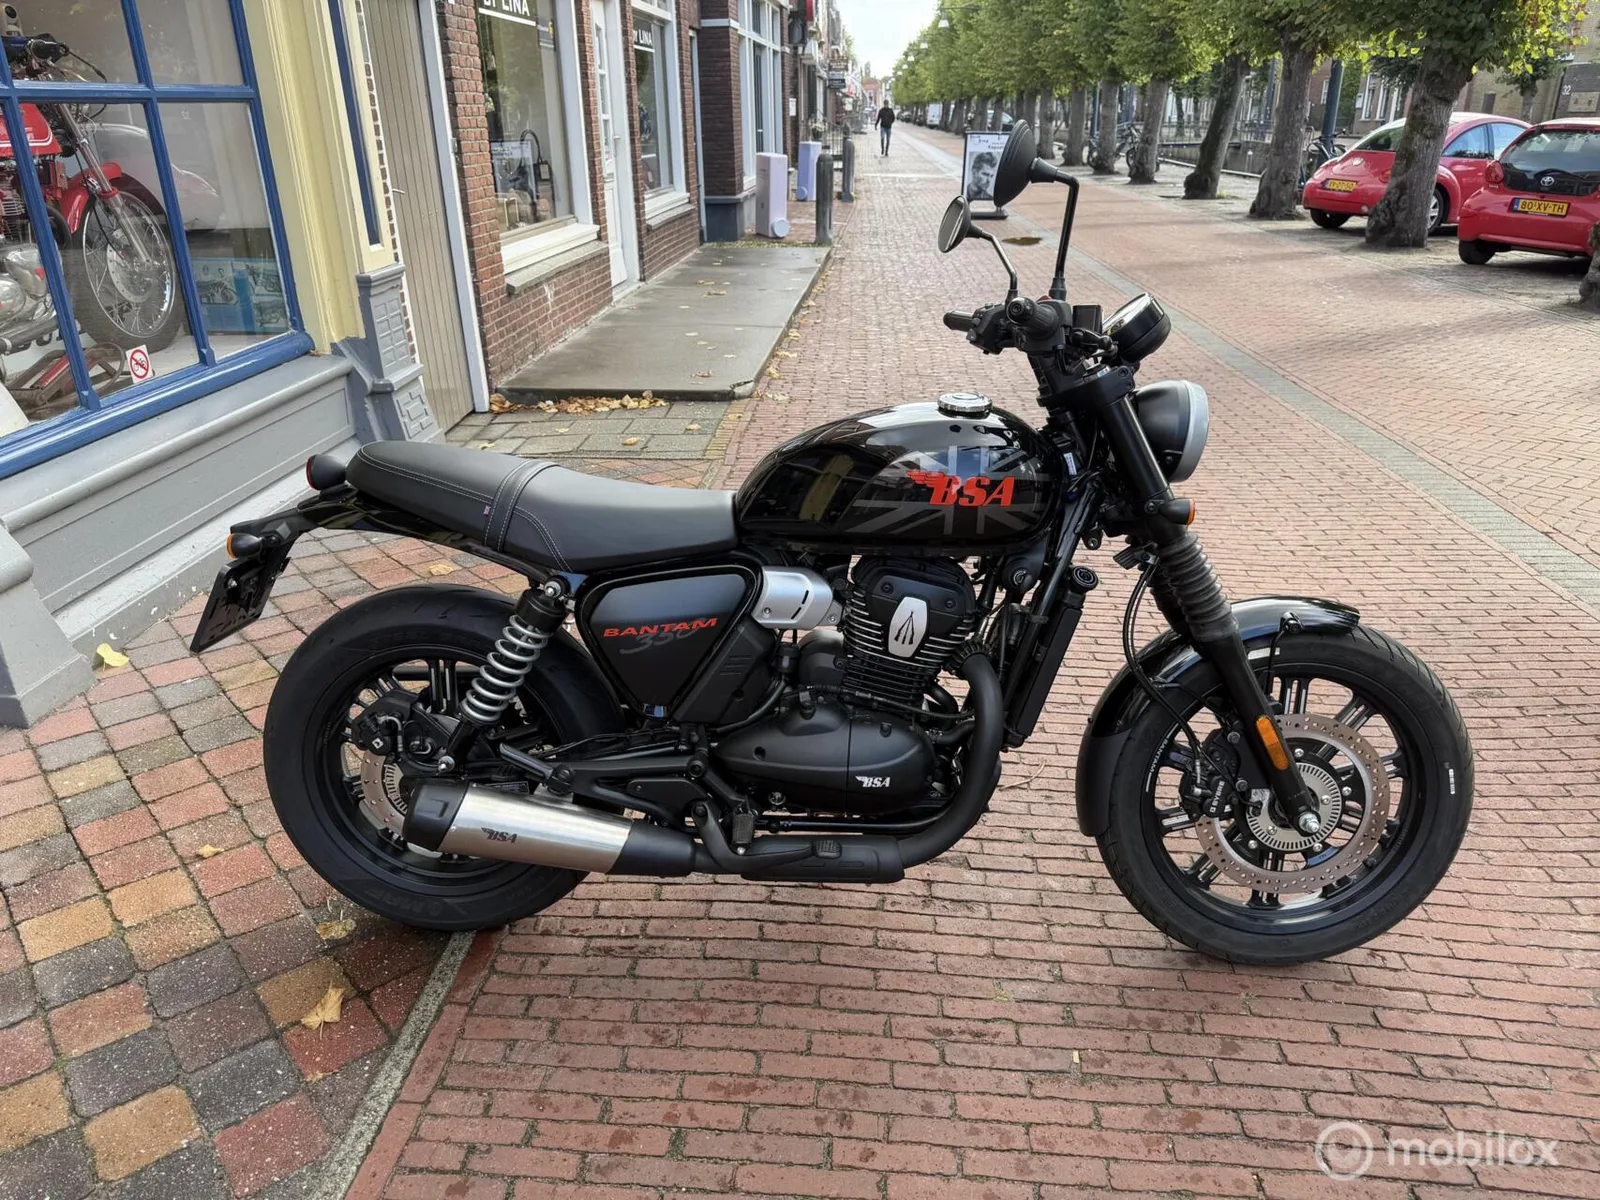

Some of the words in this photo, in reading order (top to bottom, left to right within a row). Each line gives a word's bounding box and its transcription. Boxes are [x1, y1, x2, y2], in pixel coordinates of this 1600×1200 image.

[502, 0, 530, 17] LINA
[907, 470, 1015, 507] BSA
[603, 617, 718, 637] BANTAM
[856, 775, 891, 788] BSA
[481, 827, 518, 844] BSA
